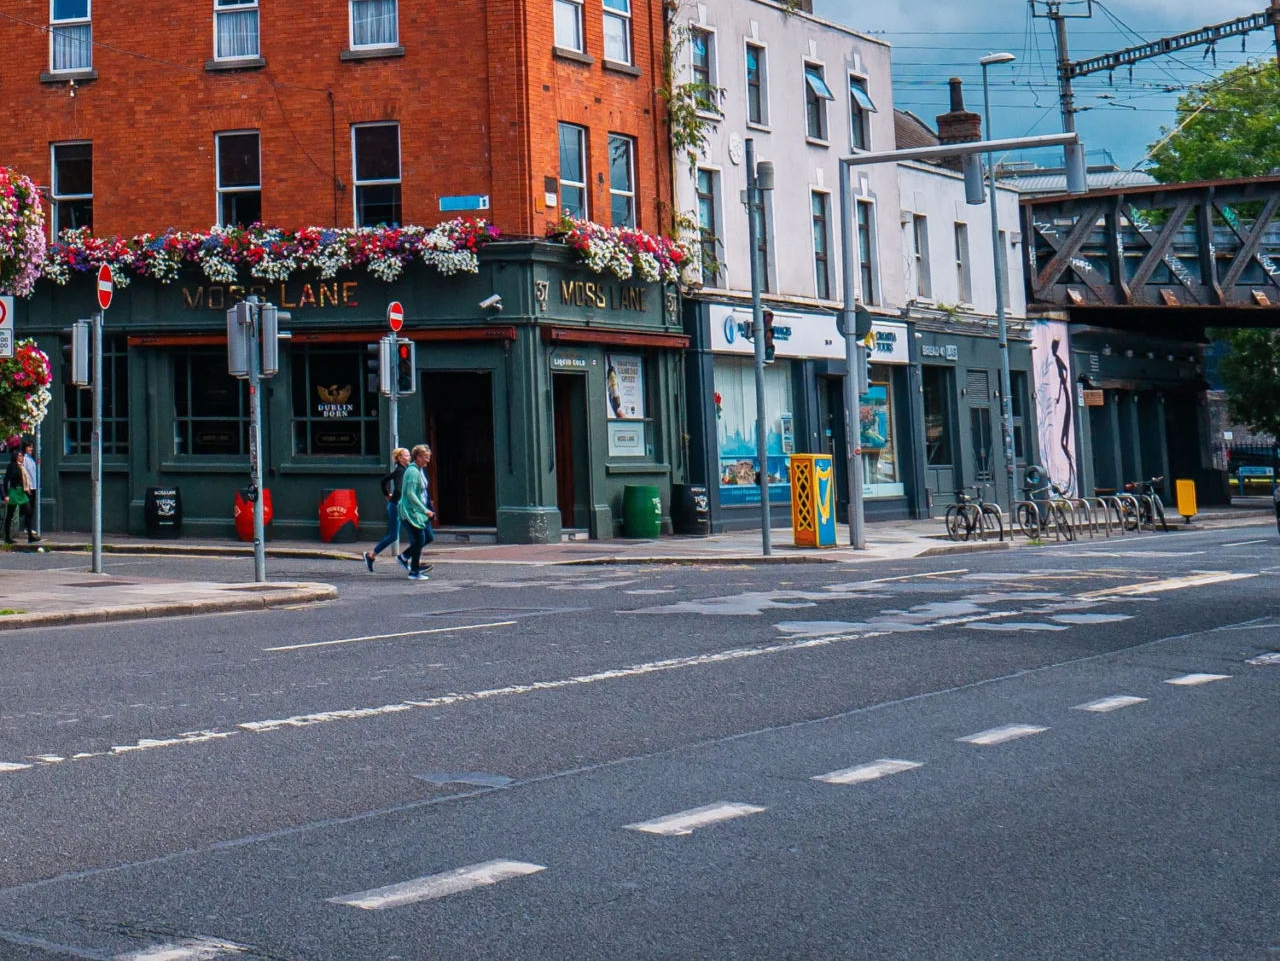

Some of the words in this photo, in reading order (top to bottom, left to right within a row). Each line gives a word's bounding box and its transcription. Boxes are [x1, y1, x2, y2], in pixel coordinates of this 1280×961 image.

[281, 282, 358, 307] LANE
[561, 279, 606, 308] MOSS
[611, 286, 647, 312] LANE
[922, 345, 939, 356] BREAD
[326, 505, 347, 514] POWERS
